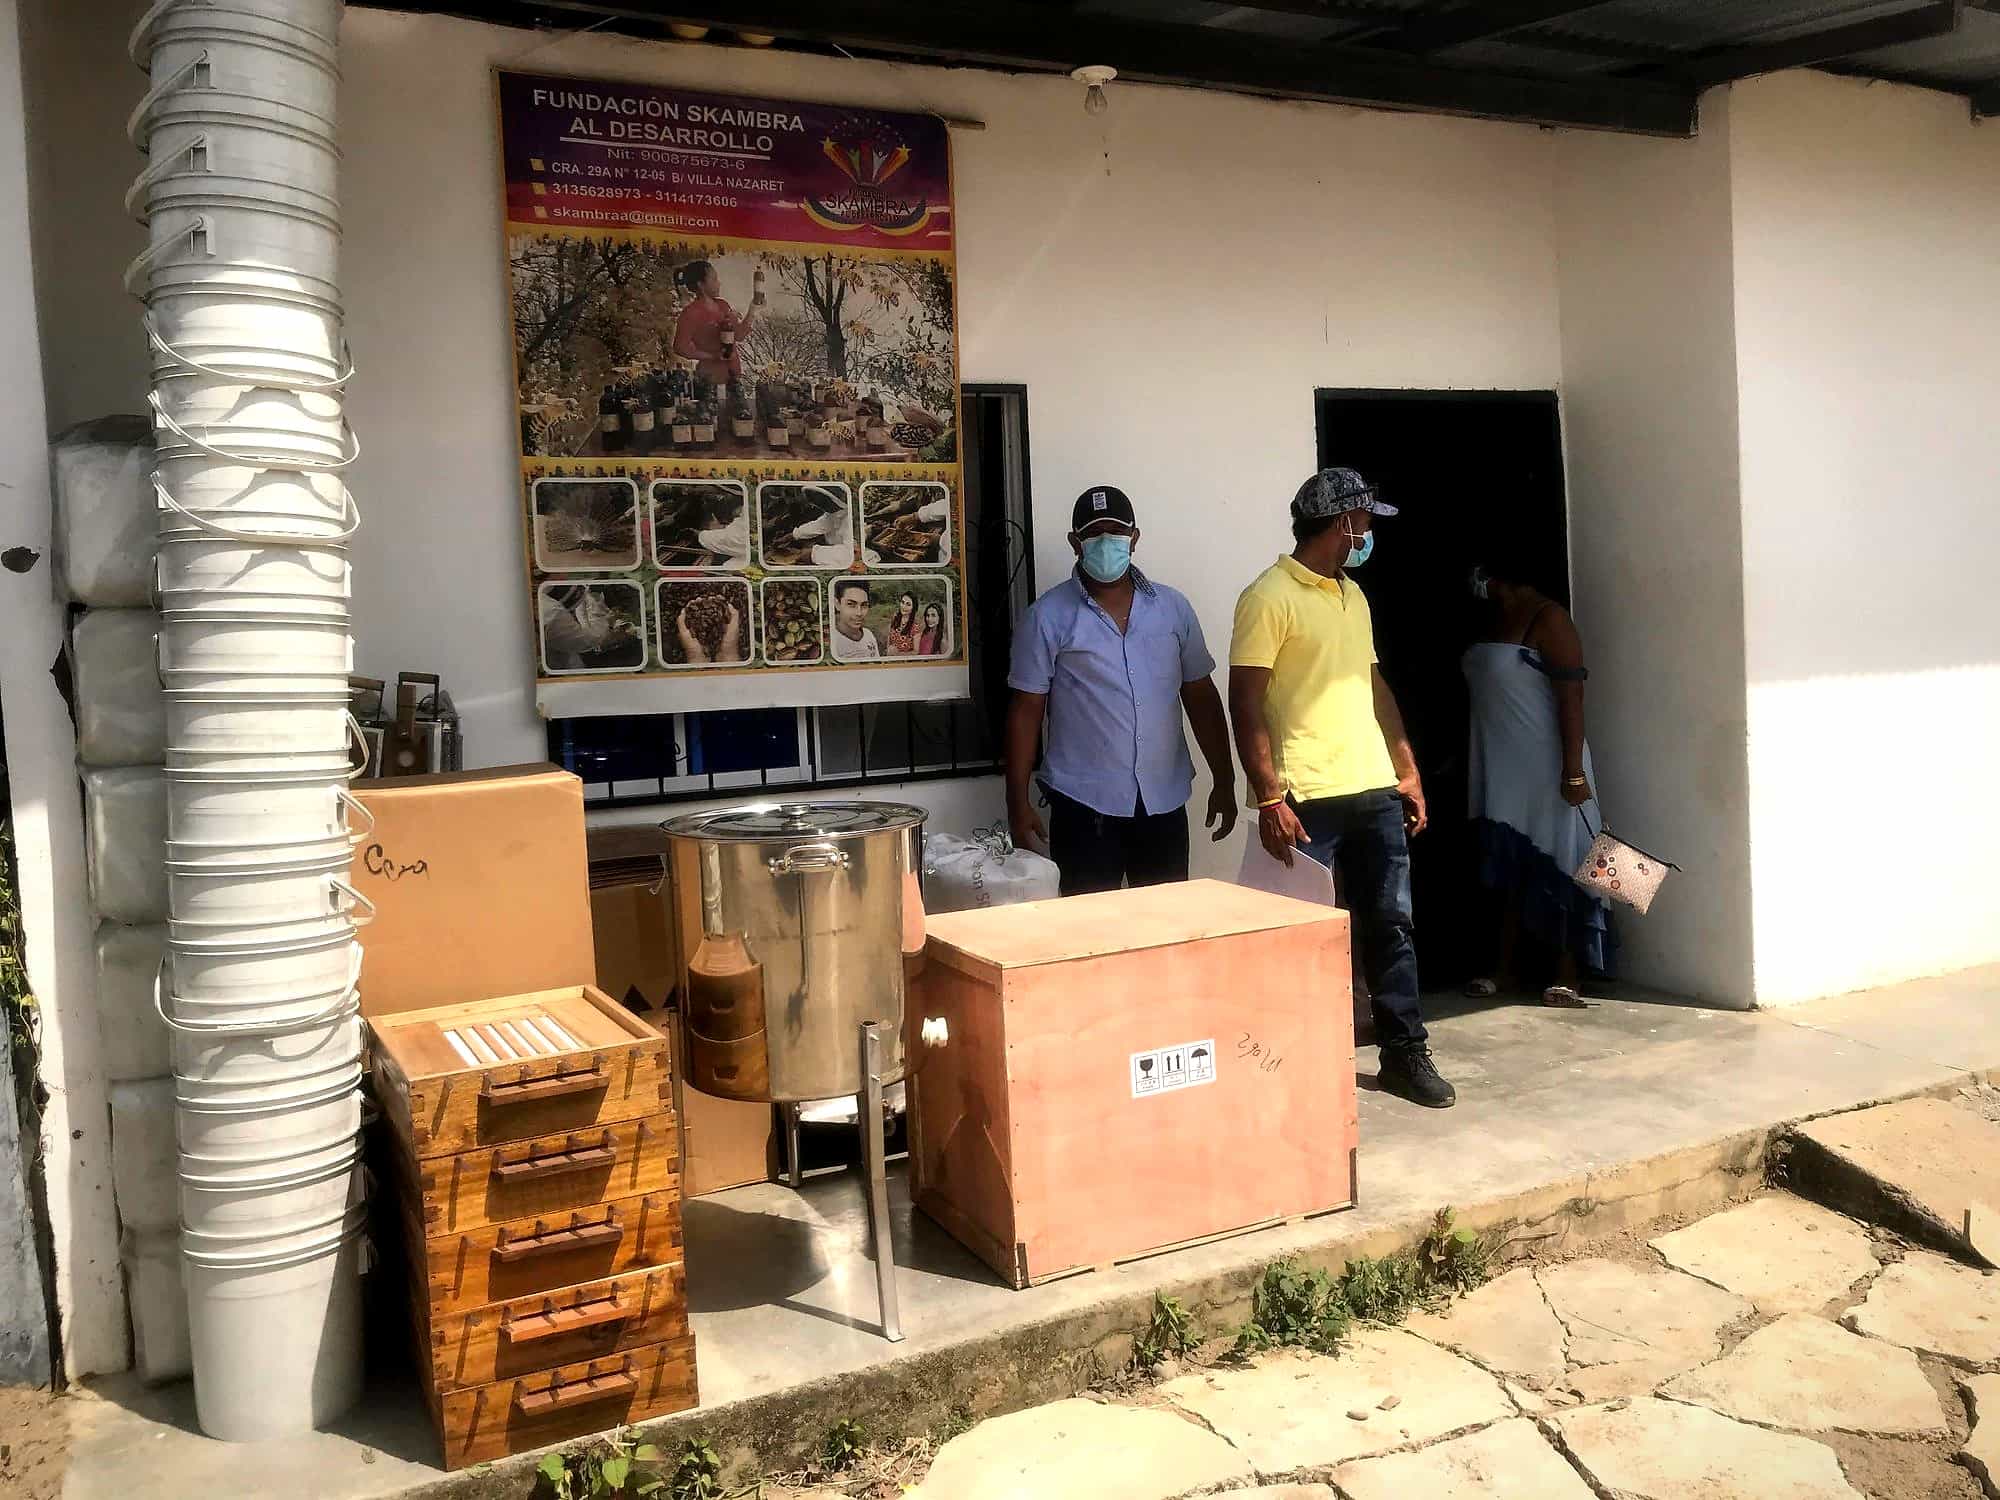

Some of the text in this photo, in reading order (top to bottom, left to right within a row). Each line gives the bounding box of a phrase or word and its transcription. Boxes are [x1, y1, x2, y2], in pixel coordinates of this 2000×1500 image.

[533, 89, 805, 132] FUNDACIÓN SKAMBRA
[569, 116, 773, 152] AL DESARROLLO
[607, 148, 745, 170] Nit: 900875673-6
[551, 161, 584, 176] CRA.
[587, 165, 612, 178] 29A
[633, 168, 665, 182] 12-05
[687, 173, 723, 187] VILLA
[726, 177, 785, 192] NAZARET
[552, 183, 641, 199] 3135628973
[655, 190, 737, 208] 3114173606
[824, 193, 911, 217] SKAMBRA
[552, 205, 719, 228] skambraa@gmail.com
